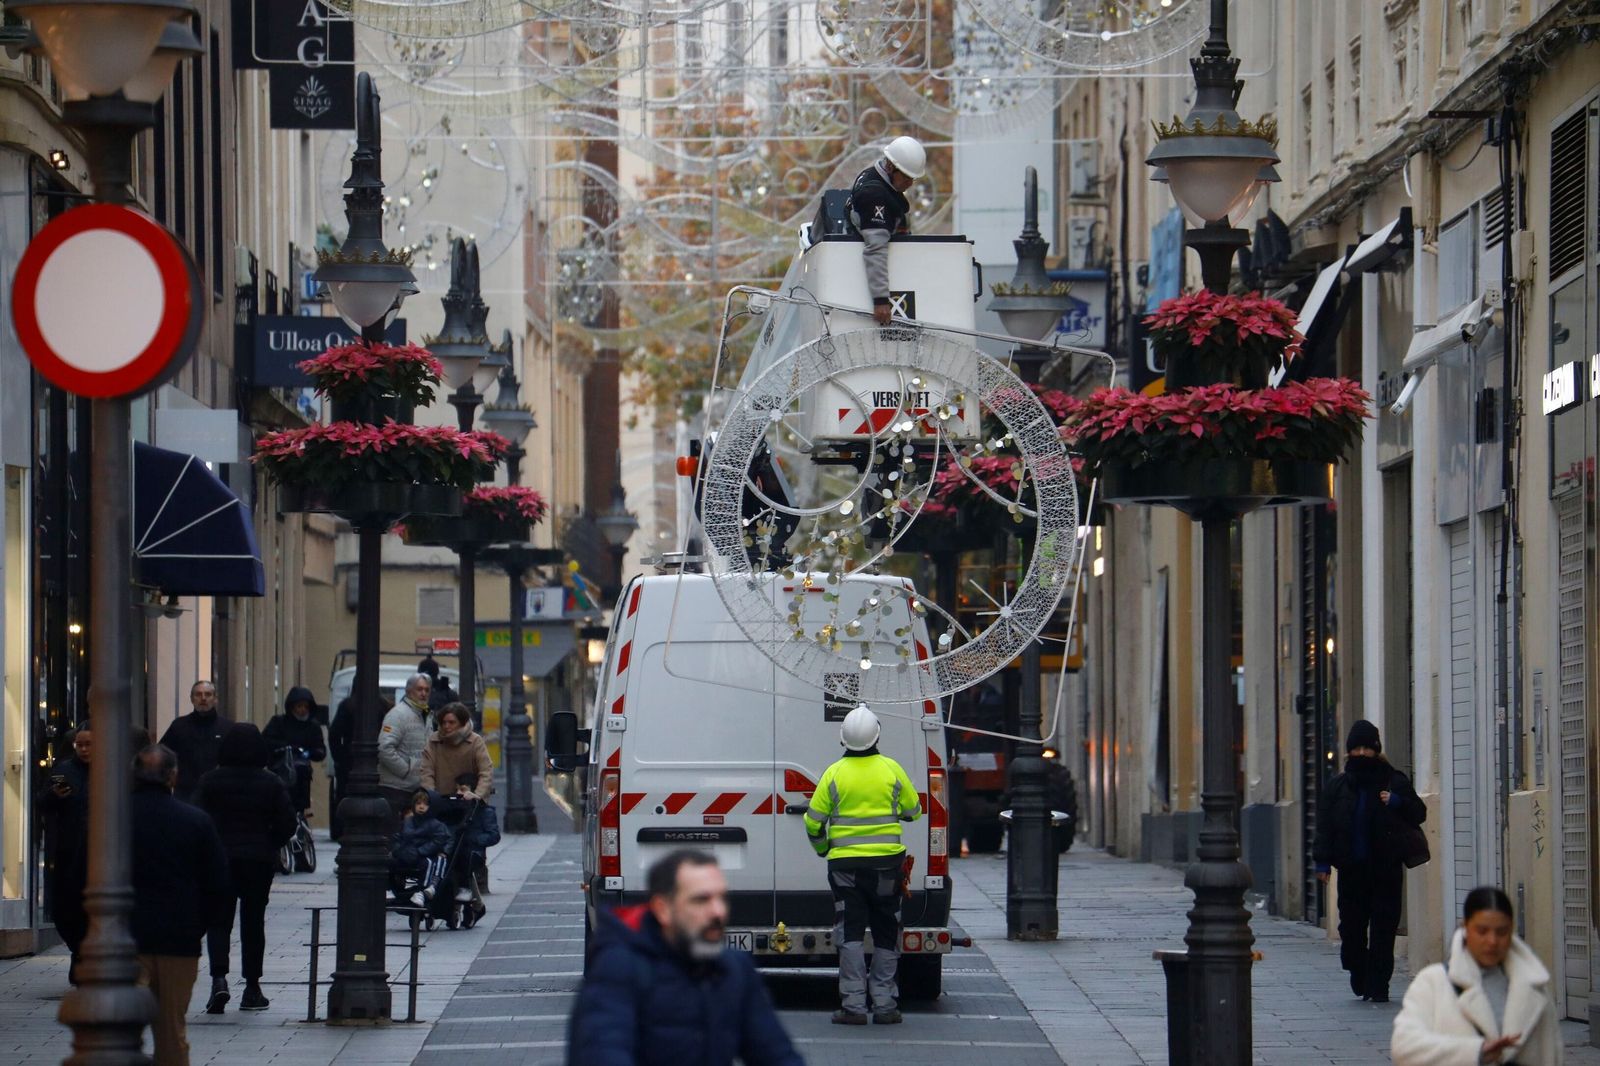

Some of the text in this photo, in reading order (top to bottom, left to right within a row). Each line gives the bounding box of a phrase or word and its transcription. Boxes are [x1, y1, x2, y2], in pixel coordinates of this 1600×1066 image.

[293, 96, 331, 106] SINAG
[268, 330, 322, 351] Ulloa
[872, 391, 930, 408] VERSFT
[664, 832, 720, 840] MASTER
